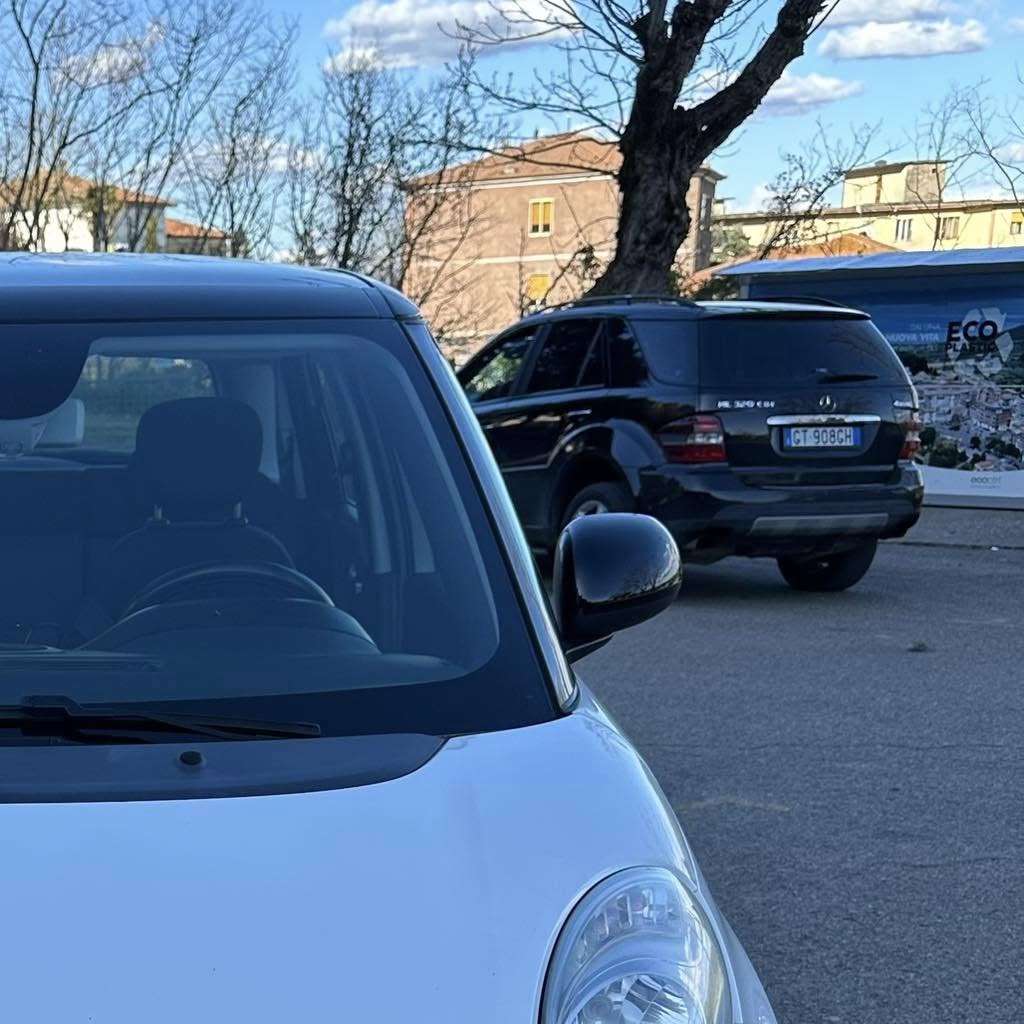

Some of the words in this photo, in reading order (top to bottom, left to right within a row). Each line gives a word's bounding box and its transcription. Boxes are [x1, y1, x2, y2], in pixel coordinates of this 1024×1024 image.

[920, 333, 939, 342] VITA
[948, 321, 997, 340] ECO
[792, 428, 807, 444] GT
[815, 428, 852, 444] 908GH
